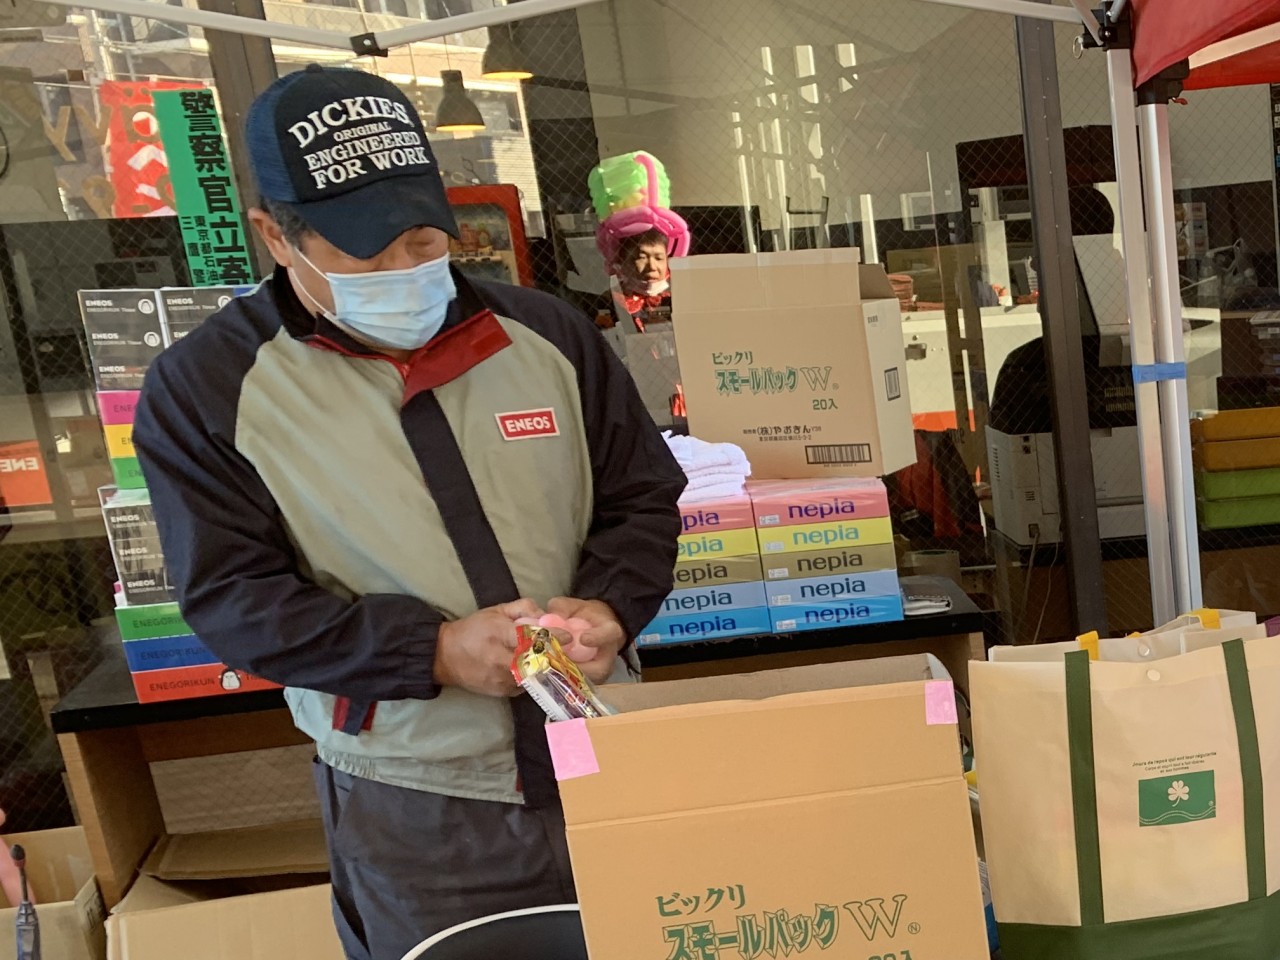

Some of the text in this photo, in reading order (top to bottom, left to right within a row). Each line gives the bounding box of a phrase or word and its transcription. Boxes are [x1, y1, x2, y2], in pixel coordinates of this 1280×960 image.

[288, 96, 410, 148] DICKIES
[333, 121, 392, 142] ORIGINAL
[304, 131, 422, 171] ENGINEERED
[311, 147, 430, 189] FOR WORK
[85, 299, 113, 307] ENEOS
[167, 297, 194, 306] ENEOS
[91, 332, 119, 340] ENEOS
[711, 350, 755, 366] ビックリ
[98, 365, 126, 373] ENEOS
[812, 398, 839, 411] 20入
[505, 416, 551, 432] ENEOS
[110, 514, 140, 524] ENEOS
[788, 497, 856, 520] nepia
[793, 524, 859, 546] nepia
[797, 551, 863, 572] nepia
[126, 579, 156, 588] ENEOS
[800, 577, 866, 599] nepia
[664, 590, 733, 612] nepia
[804, 603, 871, 624] nepia
[669, 616, 737, 637] nepia
[148, 677, 216, 693] ENEGORIKUN
[655, 884, 747, 918] ビックリ
[843, 893, 908, 941] W
